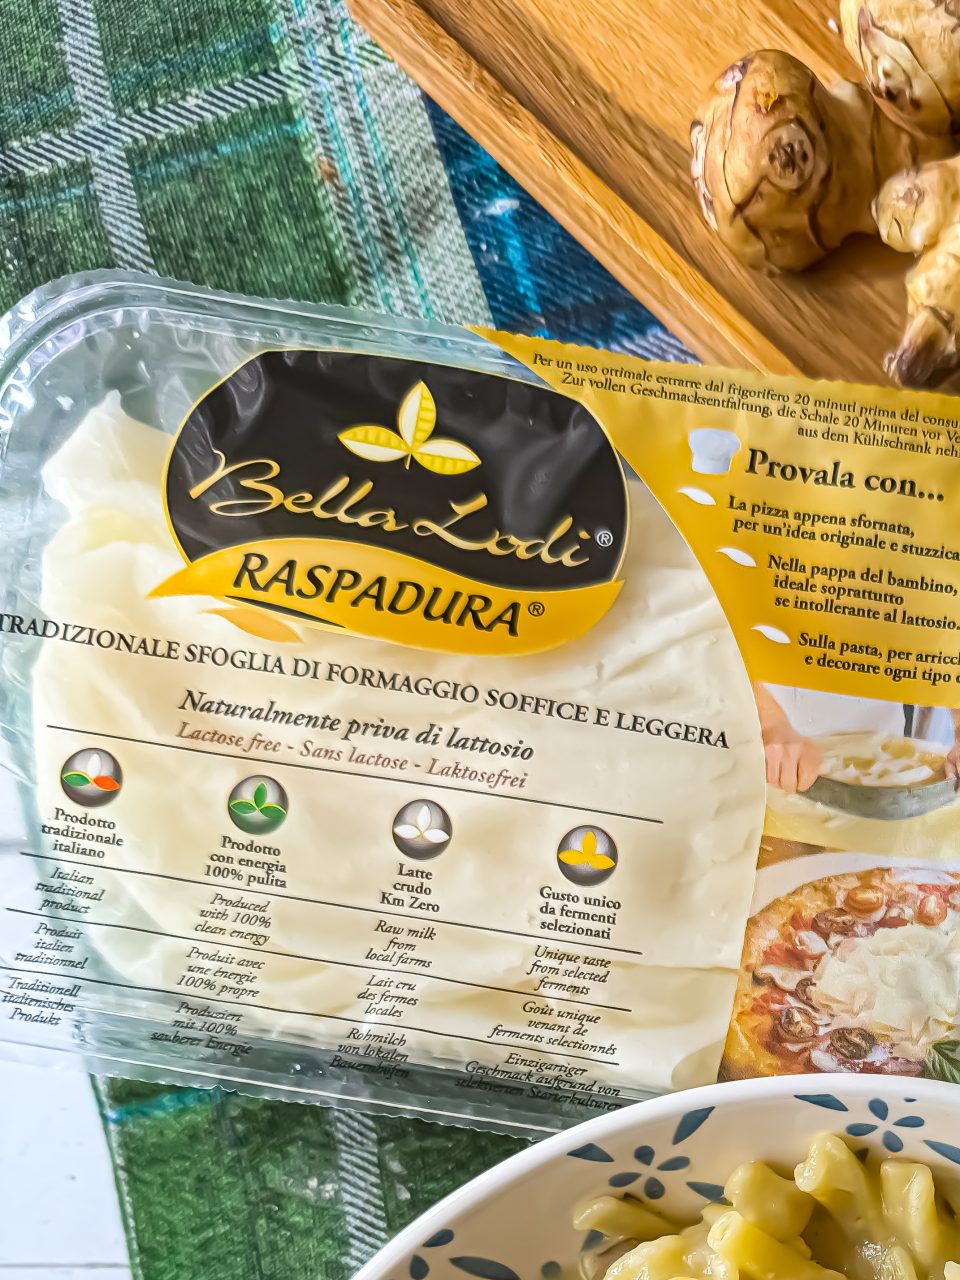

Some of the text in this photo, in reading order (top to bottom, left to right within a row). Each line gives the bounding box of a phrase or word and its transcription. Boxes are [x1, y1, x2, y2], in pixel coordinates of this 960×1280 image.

[533, 353, 553, 366] Per
[557, 360, 572, 370] un
[576, 363, 598, 374] uso
[602, 366, 652, 382] ottimale
[656, 376, 702, 390] estrarre
[705, 380, 724, 393] dal
[727, 383, 790, 403] frigorifero
[794, 394, 810, 406] 20
[814, 398, 856, 414] minuti
[860, 403, 896, 420] prima
[900, 406, 920, 422] del
[562, 372, 586, 387] Zur
[589, 377, 626, 394] vollen
[630, 383, 773, 418] Geschmacksentfaltung,
[778, 404, 796, 418] die
[800, 408, 840, 425] Schale
[843, 416, 860, 428] 20
[863, 418, 918, 437] Minuten
[922, 429, 942, 441] vor
[798, 425, 818, 438] aus
[822, 428, 849, 443] dem
[854, 431, 932, 456] Kühlschrank
[745, 448, 857, 490] Provala
[189, 449, 410, 532] Bella
[728, 496, 915, 538] La pizza appena sfornata,
[732, 518, 758, 532] per
[820, 531, 886, 550] originale
[890, 542, 898, 551] e
[768, 554, 958, 596] Nella pappa del bambino,
[774, 575, 904, 606] ideale soprattutto
[774, 596, 960, 630] se intollerante al lattosio.
[798, 632, 836, 650] Sulla
[840, 639, 883, 658] pasta,
[887, 649, 912, 662] per
[804, 655, 813, 665] e
[816, 654, 881, 674] decorare
[884, 665, 918, 681] ogni
[922, 669, 951, 685] tipo
[184, 644, 286, 675] SFOGLIA
[291, 658, 320, 680] DI
[326, 663, 480, 703] FORMAGGIO
[484, 689, 590, 723] SOFFICE
[594, 708, 610, 726] E
[614, 712, 730, 749] LEGGERA
[178, 689, 534, 761] Naturalmente priva di lattosio
[176, 722, 244, 748] Lactose
[243, 733, 282, 753] free
[299, 740, 344, 762] Sans
[349, 747, 408, 770] lactose
[425, 758, 529, 790] Laktosefrei
[54, 808, 116, 830] Prodotto
[41, 824, 124, 846] tradizionale
[52, 839, 105, 859] italiano
[221, 836, 281, 856] Prodotto
[210, 853, 287, 874] con energia
[398, 862, 433, 880] Latte
[50, 867, 94, 885] Italian
[204, 864, 288, 888] 100% pulita
[34, 882, 106, 902] traditional
[393, 882, 432, 896] crudo
[539, 886, 622, 910] Gusto unico
[38, 899, 91, 914] product
[210, 893, 270, 913] Produced
[380, 892, 440, 912] Km Zero
[200, 908, 272, 928] with 100%
[539, 902, 616, 925] da fermenti
[34, 922, 84, 940] Produit
[194, 920, 270, 946] clean energy
[374, 920, 436, 940] Raw milk
[540, 919, 611, 940] selezionati
[34, 938, 74, 953] italien
[383, 937, 416, 952] from
[14, 951, 88, 970] traditionnel
[186, 946, 266, 970] Produit avec
[365, 948, 432, 968] local farms
[534, 944, 612, 968] Unique taste
[187, 964, 212, 976] une
[526, 960, 610, 983] from selected
[8, 976, 82, 998] Traditionell
[177, 975, 260, 998] 100% propre
[366, 974, 416, 991] Lait cru
[534, 976, 591, 995] ferments
[357, 988, 419, 1006] des fermes
[9, 1007, 62, 1026] Produkt
[364, 1003, 404, 1017] locales
[522, 1001, 601, 1024] Goût unique
[171, 1019, 238, 1036] mit 100%
[347, 1028, 407, 1047] Rohmilch
[487, 1024, 544, 1043] ferments
[528, 1020, 588, 1036] venant de
[206, 1036, 253, 1056] Energie
[338, 1043, 408, 1062] von lokalen
[504, 1052, 588, 1078] Einzigartiger
[464, 1061, 621, 1097] Geschmack aufgrund von
